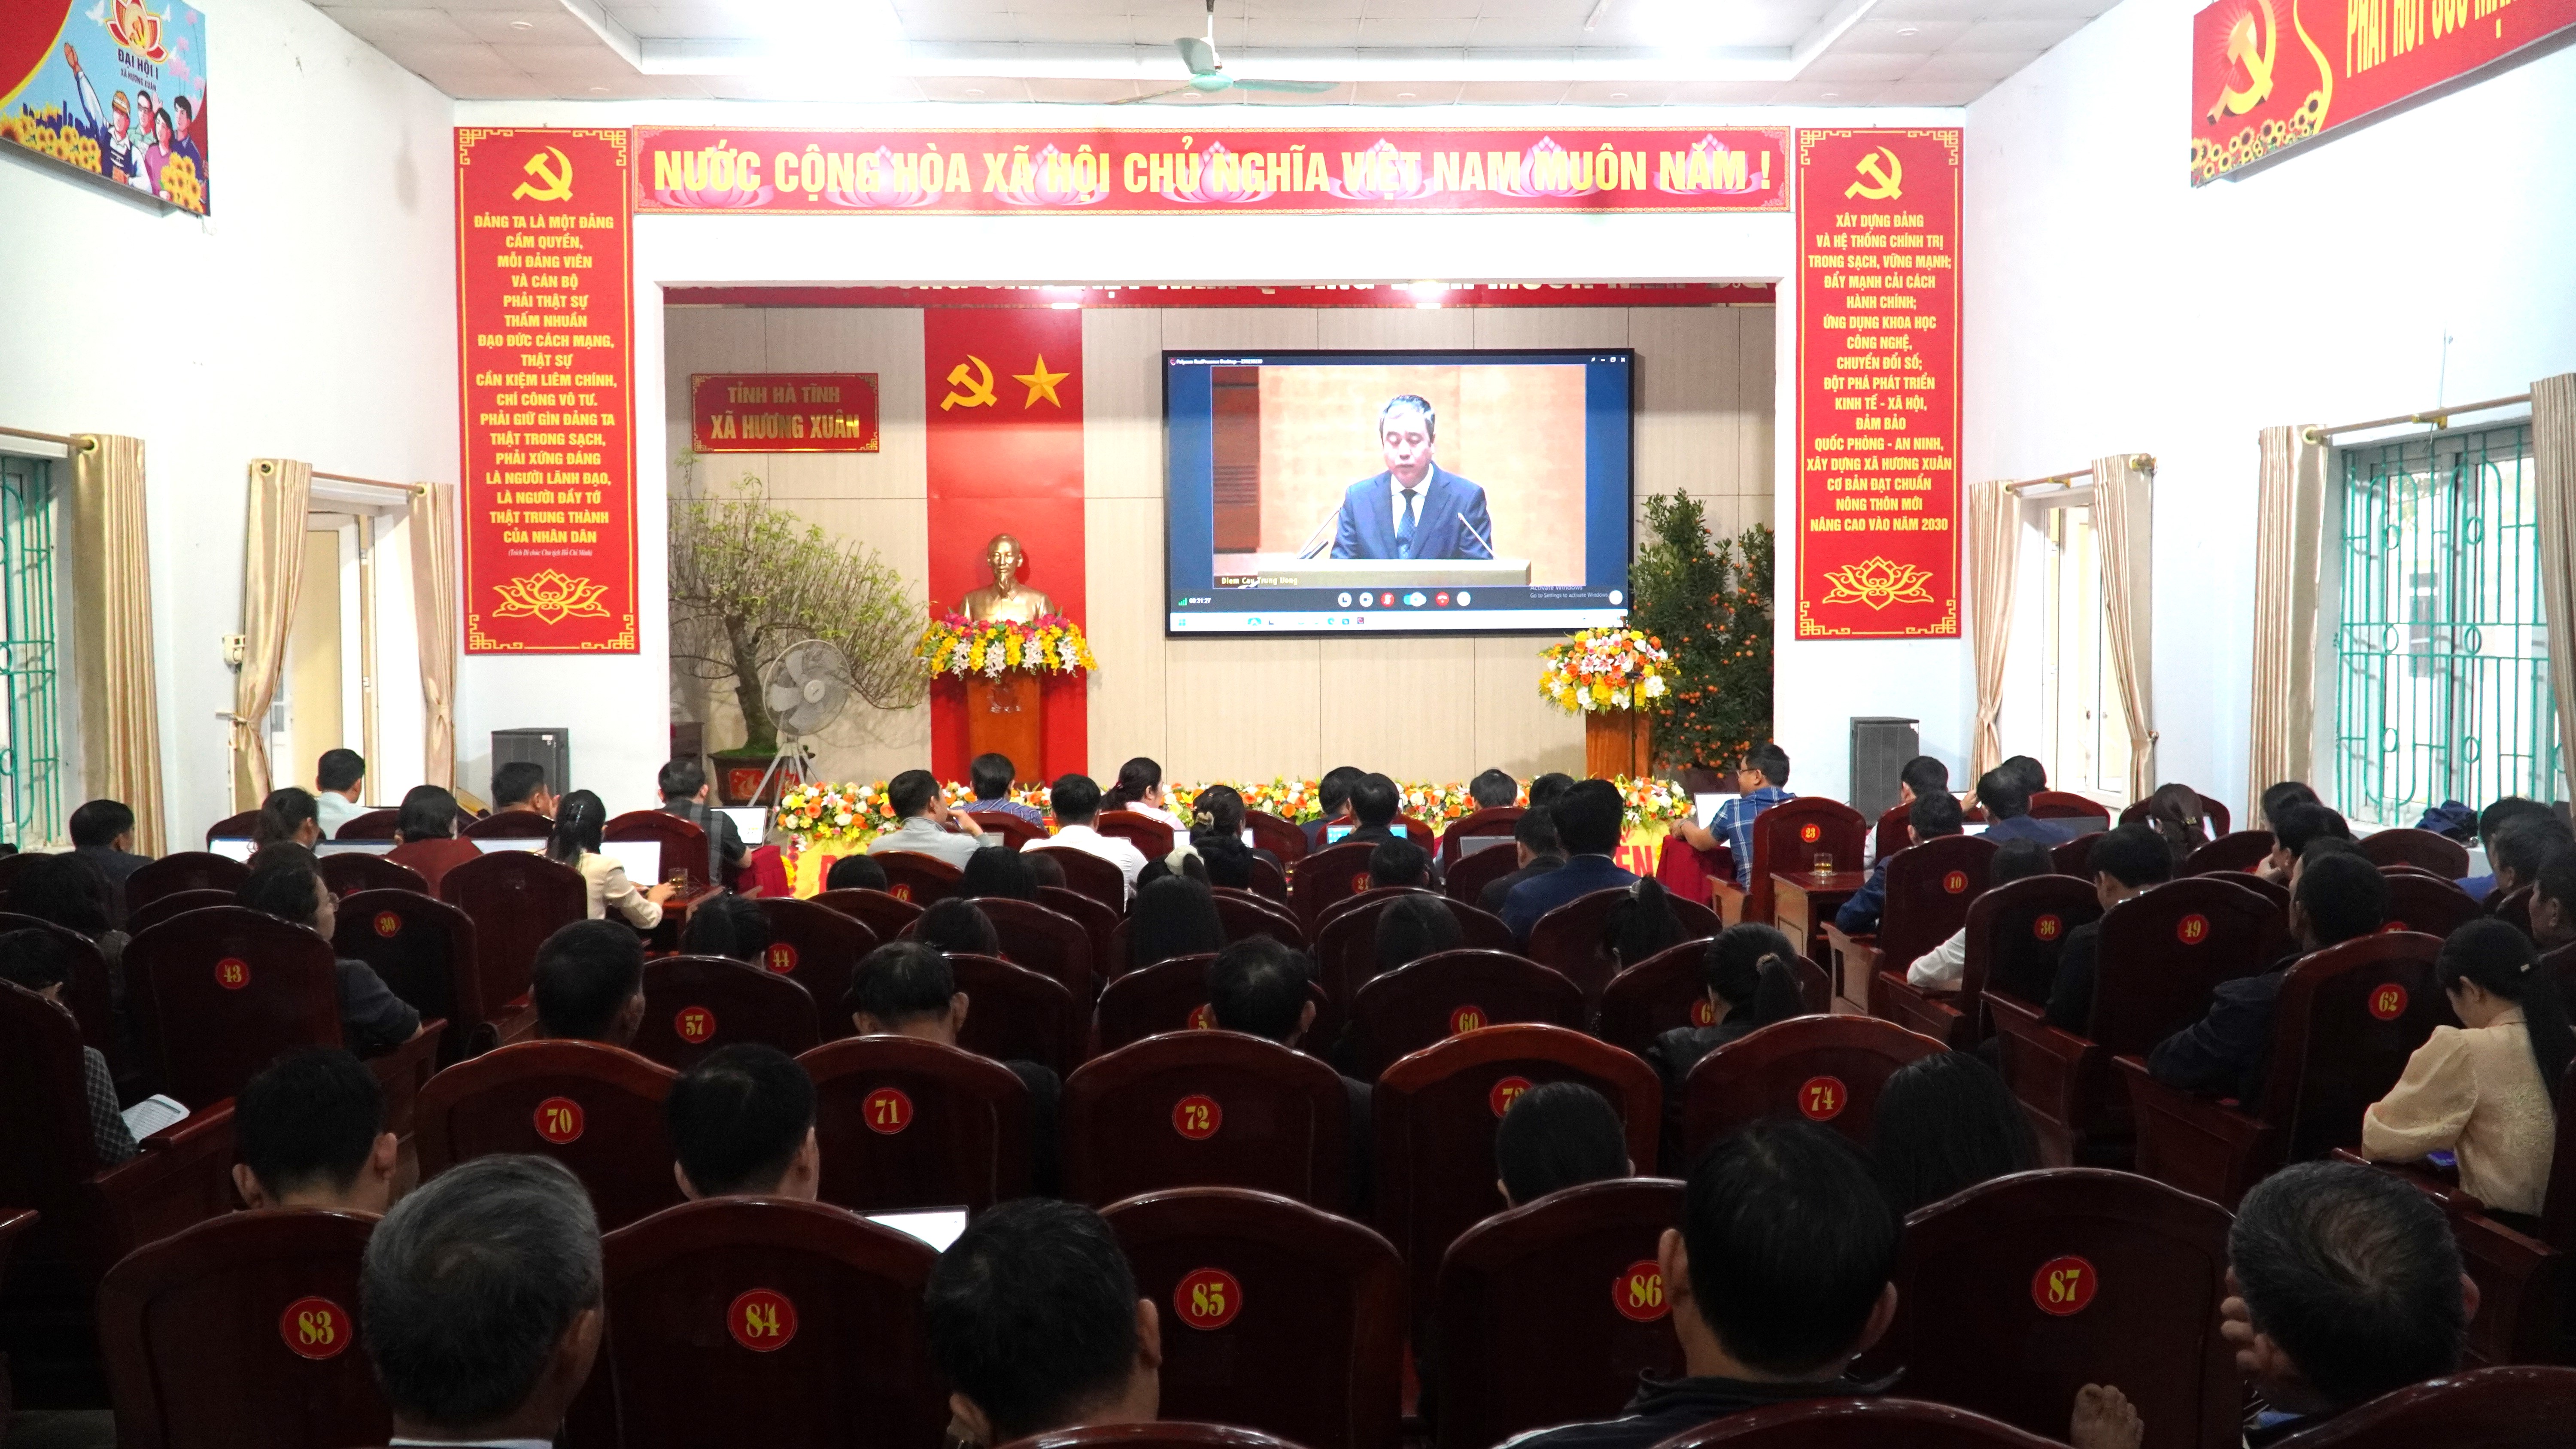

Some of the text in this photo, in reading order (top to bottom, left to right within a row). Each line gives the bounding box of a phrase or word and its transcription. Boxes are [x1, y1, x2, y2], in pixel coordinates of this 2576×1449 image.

[118, 48, 158, 80] ĐẠI HỘI I
[655, 136, 1771, 201] NƯỚC CỘNG HÒA XÃ HỘI CHỦ NGHĨA VIỆT NAM MUÔN NĂM !
[474, 212, 614, 231] ĐẢNG TA LÀ MỘT ĐẢNG
[1836, 211, 1924, 230] XÂY DỰNG ĐẢNG
[1817, 231, 1943, 250] VÀ HỆ THỐNG CHÍNH TRỊ
[1808, 253, 1951, 270] TRONG SẠCH, VỮNG MẠNH;
[512, 273, 578, 290] VÀ CÁN BỘ
[1824, 271, 1935, 291] ĐẨY MẠNH CẢI CÁCH
[504, 292, 589, 310] PHẢI THẬT SỰ
[1847, 294, 1916, 310] HÀNH CHÍNH;
[1823, 314, 1936, 331] ỨNG DỤNG KHOA HỌC
[478, 332, 614, 349] ĐẠO ĐỨC CÁCH MẠNG,
[1847, 334, 1912, 352] CÔNG NGHỆ,
[1837, 352, 1922, 371] CHUYỂN ĐỔI SỐ;
[1824, 372, 1935, 392] ĐỘT PHÁ PHÁT TRIỂN
[728, 381, 840, 404] TỈNH HÀ TĨNH
[1835, 394, 1927, 412] KINH TẾ XÃ HỘI,
[480, 410, 615, 425] PHẢI GIỮ GÌN ĐẢNG TA
[711, 409, 860, 439] XÃ HƯƠNG XUÂN
[1856, 413, 1906, 430] ĐẢM BẢO
[490, 431, 605, 447] THẬT TRONG SẠCH,
[1815, 434, 1944, 452] QUỐC PHÒNG AN NINH,
[496, 449, 601, 465] PHẢI XỨNG ĐÁNG
[1807, 455, 1952, 473] XÂY DỰNG XÃ HƯƠNG XUÂN
[486, 470, 611, 486] LÀ NGƯỜI LÃNH ĐẠO,
[1827, 473, 1931, 493] CƠ BẢN ĐẠT CHUẨN
[1836, 496, 1922, 510] NÔNG THÔN MỚI
[490, 509, 609, 526] THẬT TRUNG THÀNH
[1810, 516, 1948, 531] NÂNG CAO VÀO NĂM 2030
[504, 528, 597, 543] CỦA NHÂN DÂN
[1257, 577, 1277, 585] Trung
[1280, 577, 1298, 585] Uong
[1806, 828, 1816, 838] 23
[1950, 878, 1962, 889] 10
[380, 918, 395, 932] 30
[2041, 922, 2055, 935] 36
[2185, 920, 2202, 937] 49
[773, 950, 790, 967] 44
[224, 966, 242, 982] 43
[2379, 993, 2398, 1012] 62
[686, 1015, 704, 1035] 57
[1459, 1013, 1478, 1031] 60
[1811, 1088, 1835, 1111] 74
[547, 1109, 573, 1133] 70
[875, 1100, 898, 1124] 71
[1186, 1106, 1210, 1130] 72
[1630, 1275, 1662, 1307] 86
[2049, 1269, 2081, 1302] 87
[1193, 1283, 1225, 1316] 85
[299, 1311, 335, 1344] 83
[746, 1303, 781, 1337] 84
